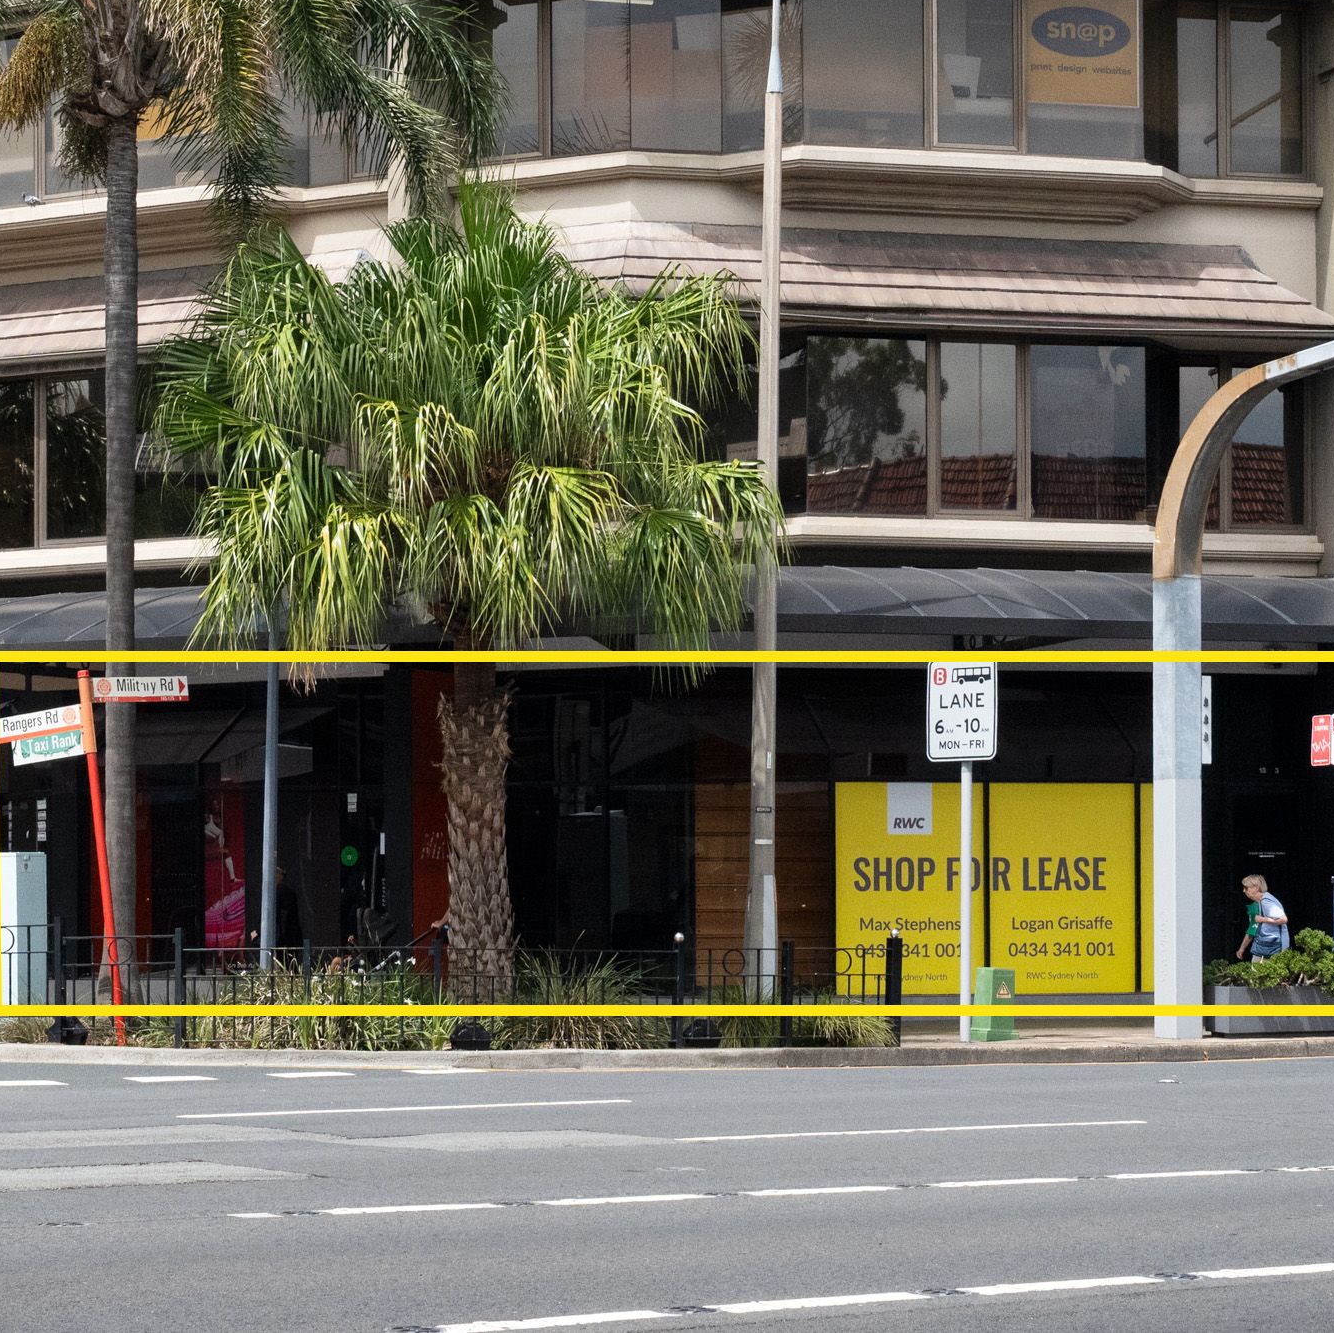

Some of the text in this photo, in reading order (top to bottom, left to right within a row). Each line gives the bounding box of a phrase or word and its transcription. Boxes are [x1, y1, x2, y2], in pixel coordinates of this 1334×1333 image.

[1057, 63, 1087, 74] design
[1093, 65, 1132, 75] websites
[159, 678, 174, 691] Rd
[939, 692, 985, 709] LANE
[2, 710, 59, 733] Rangers Rd
[27, 732, 78, 753] Taxi Rank
[892, 817, 925, 829] RWC
[853, 856, 936, 892] SHOP
[1022, 856, 1107, 891] LEASE
[859, 917, 961, 934] Max Stephens
[1011, 915, 1113, 933] Logan Grisaffe
[855, 943, 886, 958] 043
[1008, 941, 1116, 957] 0434 341 001
[902, 972, 923, 983] ydney
[926, 972, 948, 981] North
[1026, 971, 1099, 982] RWC Sydney North
